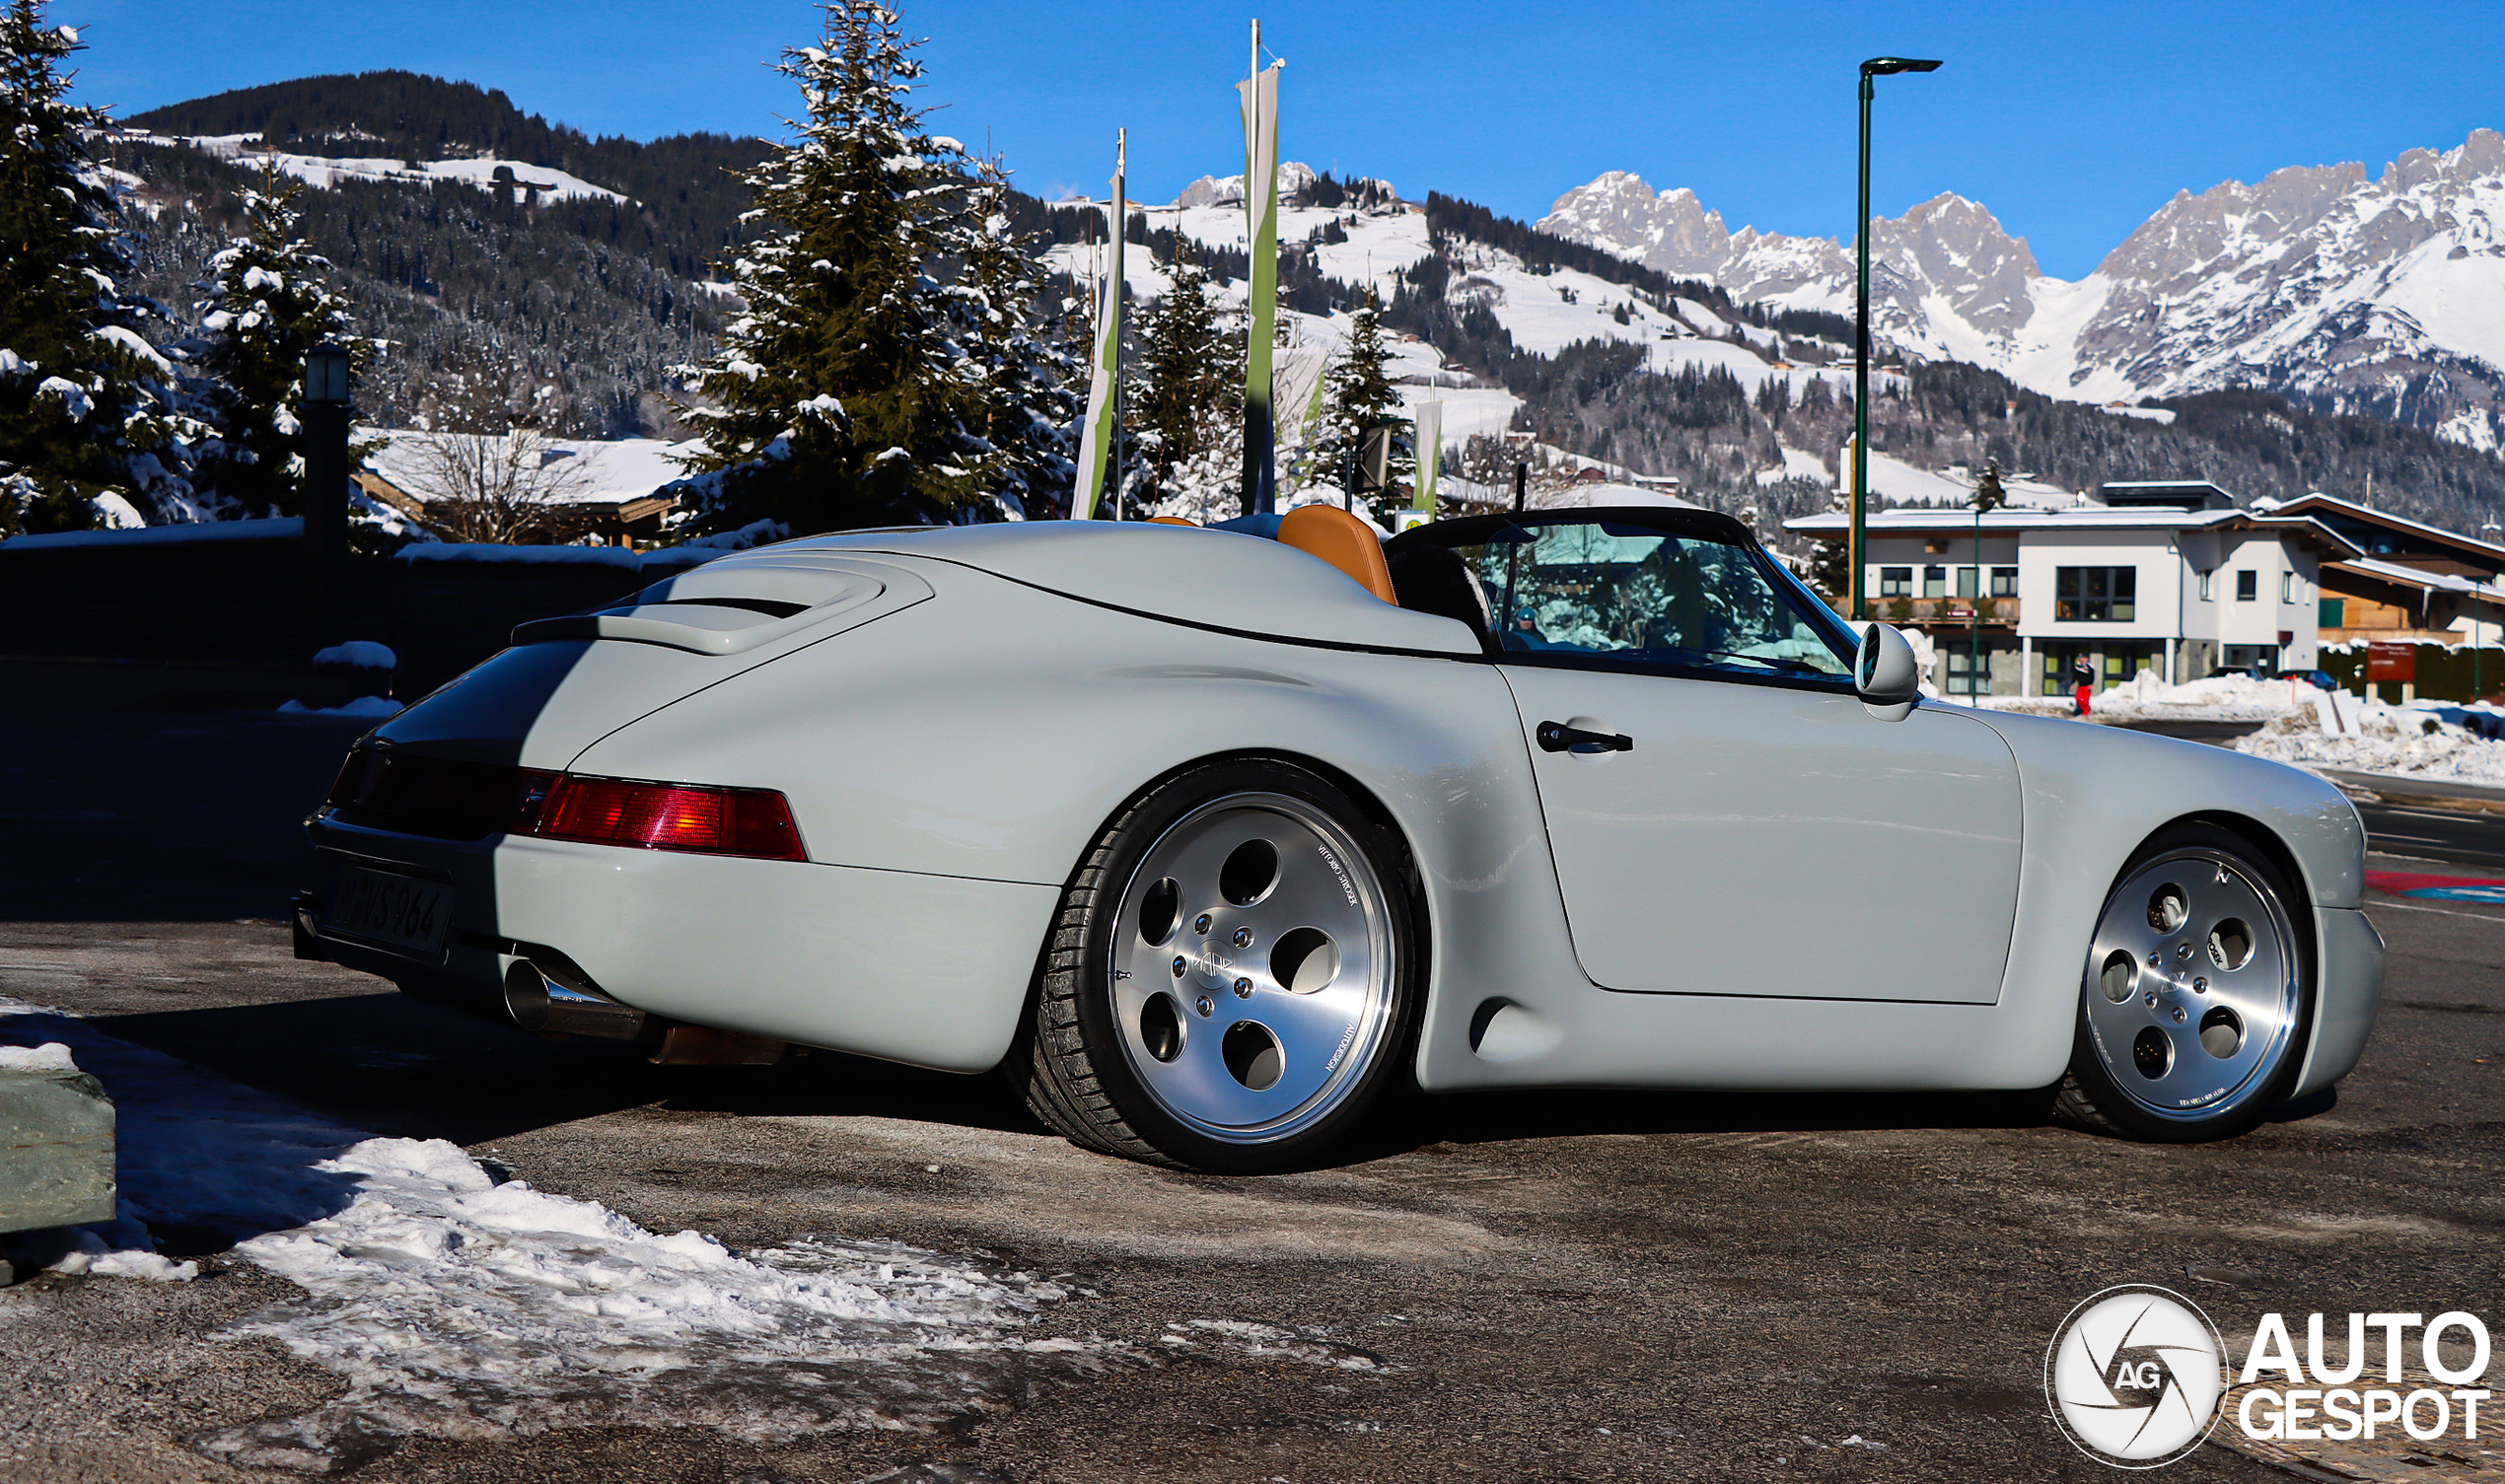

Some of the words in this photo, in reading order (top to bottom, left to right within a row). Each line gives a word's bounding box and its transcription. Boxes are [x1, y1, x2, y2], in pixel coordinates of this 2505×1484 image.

[1318, 844, 1342, 875] VITTORIO
[1338, 874, 1358, 907] STROSEK
[363, 878, 395, 931] VS
[392, 884, 442, 942] 964
[1324, 1021, 1356, 1073] AUTODESIGN
